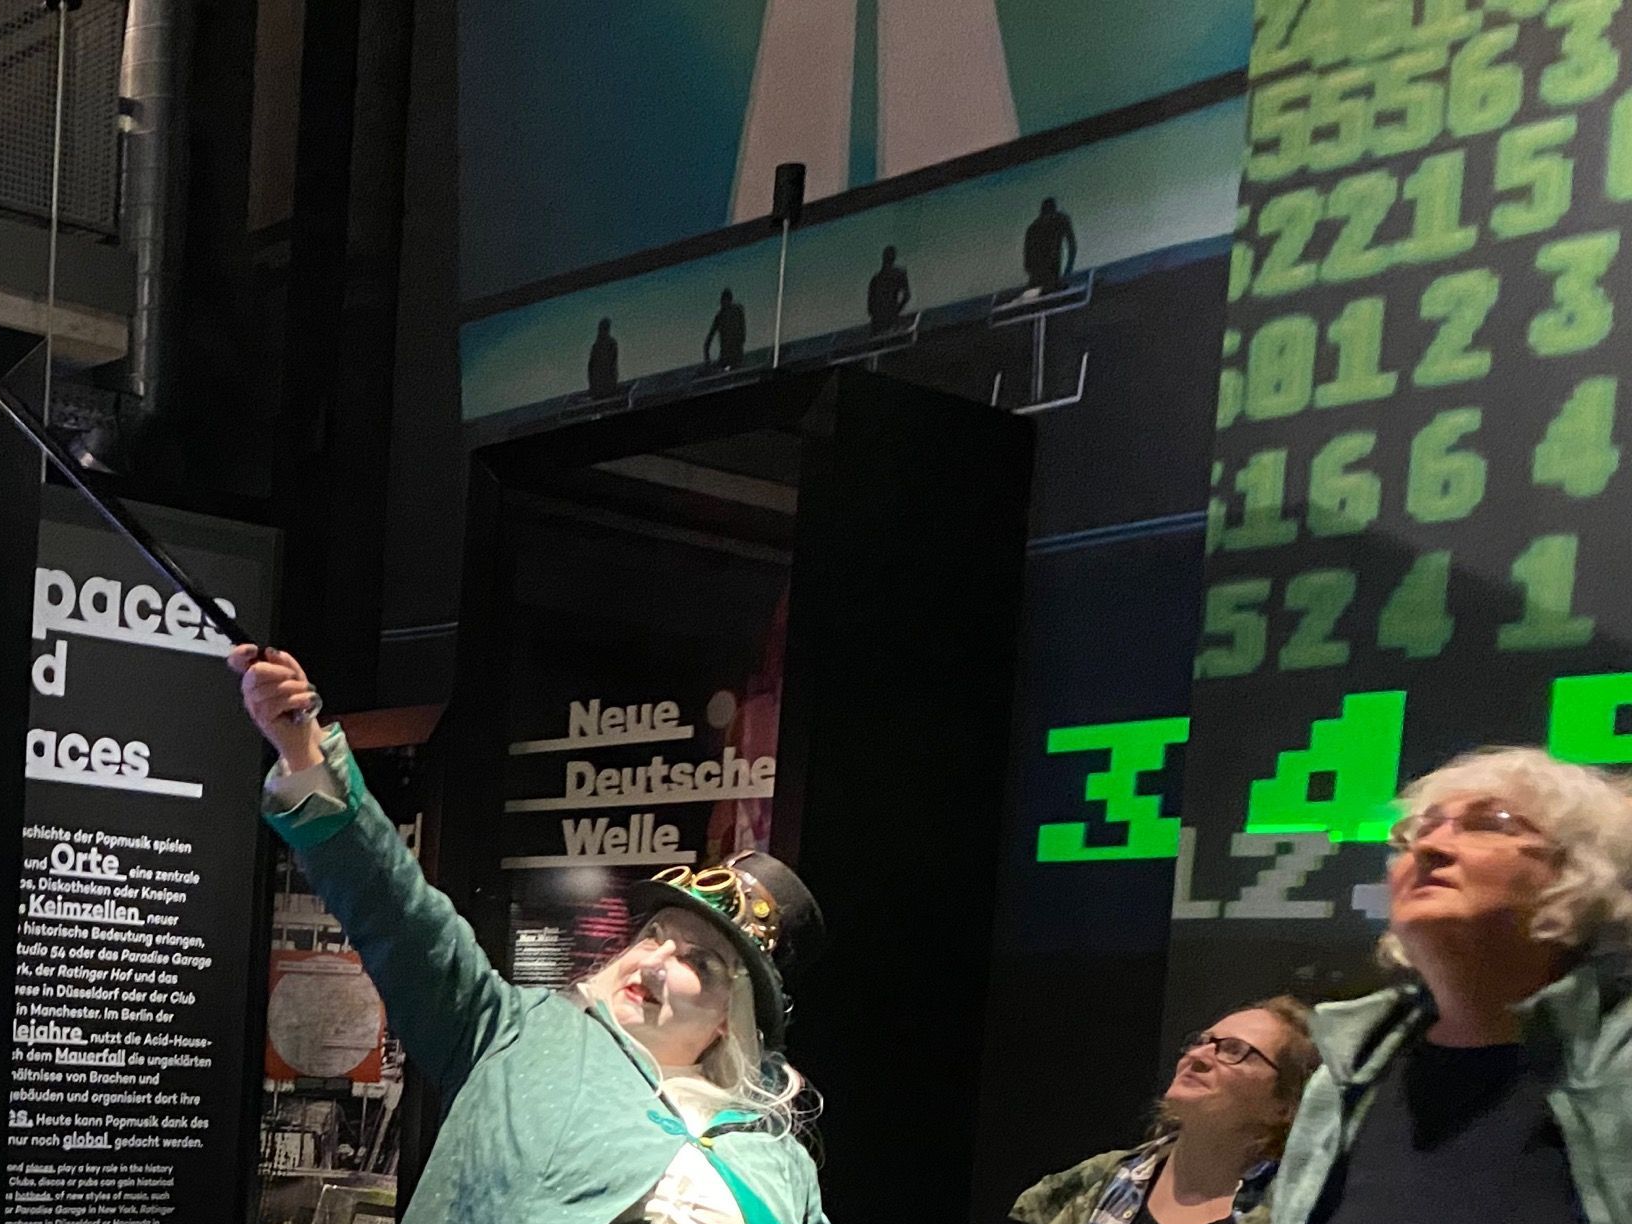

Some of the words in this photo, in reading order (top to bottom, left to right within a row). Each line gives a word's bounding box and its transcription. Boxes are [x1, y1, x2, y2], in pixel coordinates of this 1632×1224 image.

[32, 566, 236, 657] paces
[31, 641, 68, 696] d
[548, 698, 686, 748] Neue
[25, 727, 158, 792] aces
[553, 746, 775, 803] Deutsche
[72, 829, 92, 844] der
[94, 830, 150, 851] Popmusik
[152, 835, 191, 854] spielen
[543, 813, 686, 862] Welle
[24, 855, 48, 871] und
[50, 841, 122, 880] Orte
[128, 863, 153, 879] eine
[155, 866, 200, 884] zentrale
[37, 877, 110, 895] Diskotheken
[112, 882, 139, 897] oder
[140, 884, 186, 904] Kneipen
[27, 893, 143, 925] Keimzellen
[147, 914, 180, 926] neuer
[24, 921, 89, 938] historische
[91, 925, 152, 946] Bedeutung
[154, 930, 204, 950] erlangen,
[16, 941, 47, 956] tudio
[49, 943, 66, 957] 54
[68, 944, 95, 959] oder
[97, 946, 119, 960] das
[121, 948, 170, 964] Paradise
[172, 951, 212, 970] Garage
[16, 962, 33, 979] rk,
[34, 963, 55, 977] der
[110, 967, 132, 981] Hof
[134, 969, 156, 983] und
[158, 970, 178, 984] das
[42, 984, 55, 997] in
[57, 984, 119, 1000] Düsseldorf
[121, 987, 147, 1002] oder
[149, 989, 169, 1003] der
[170, 990, 196, 1004] Club
[15, 1001, 27, 1015] in
[103, 1006, 119, 1020] Im
[121, 1007, 154, 1021] Berlin
[156, 1008, 174, 1022] der
[89, 1030, 121, 1044] nutzt
[123, 1031, 143, 1044] die
[144, 1031, 213, 1046] Acid-House-
[26, 1048, 53, 1062] dem
[55, 1047, 126, 1067] Mauerfall
[127, 1052, 146, 1065] die
[147, 1052, 212, 1070] ungeklärten
[64, 1072, 87, 1082] von
[89, 1069, 137, 1083] Brachen
[139, 1070, 160, 1084] und
[65, 1089, 88, 1102] und
[90, 1089, 152, 1107] organisiert
[154, 1091, 177, 1104] dort
[179, 1092, 201, 1105] ihre
[35, 1113, 72, 1126] Heute
[73, 1113, 102, 1127] kann
[104, 1114, 158, 1131] Popmusik
[160, 1115, 188, 1128] dank
[190, 1115, 210, 1128] des
[7, 1136, 28, 1145] nur
[30, 1132, 61, 1146] noch
[62, 1130, 111, 1150] global
[113, 1134, 159, 1151] gedacht
[161, 1135, 204, 1148] werden.
